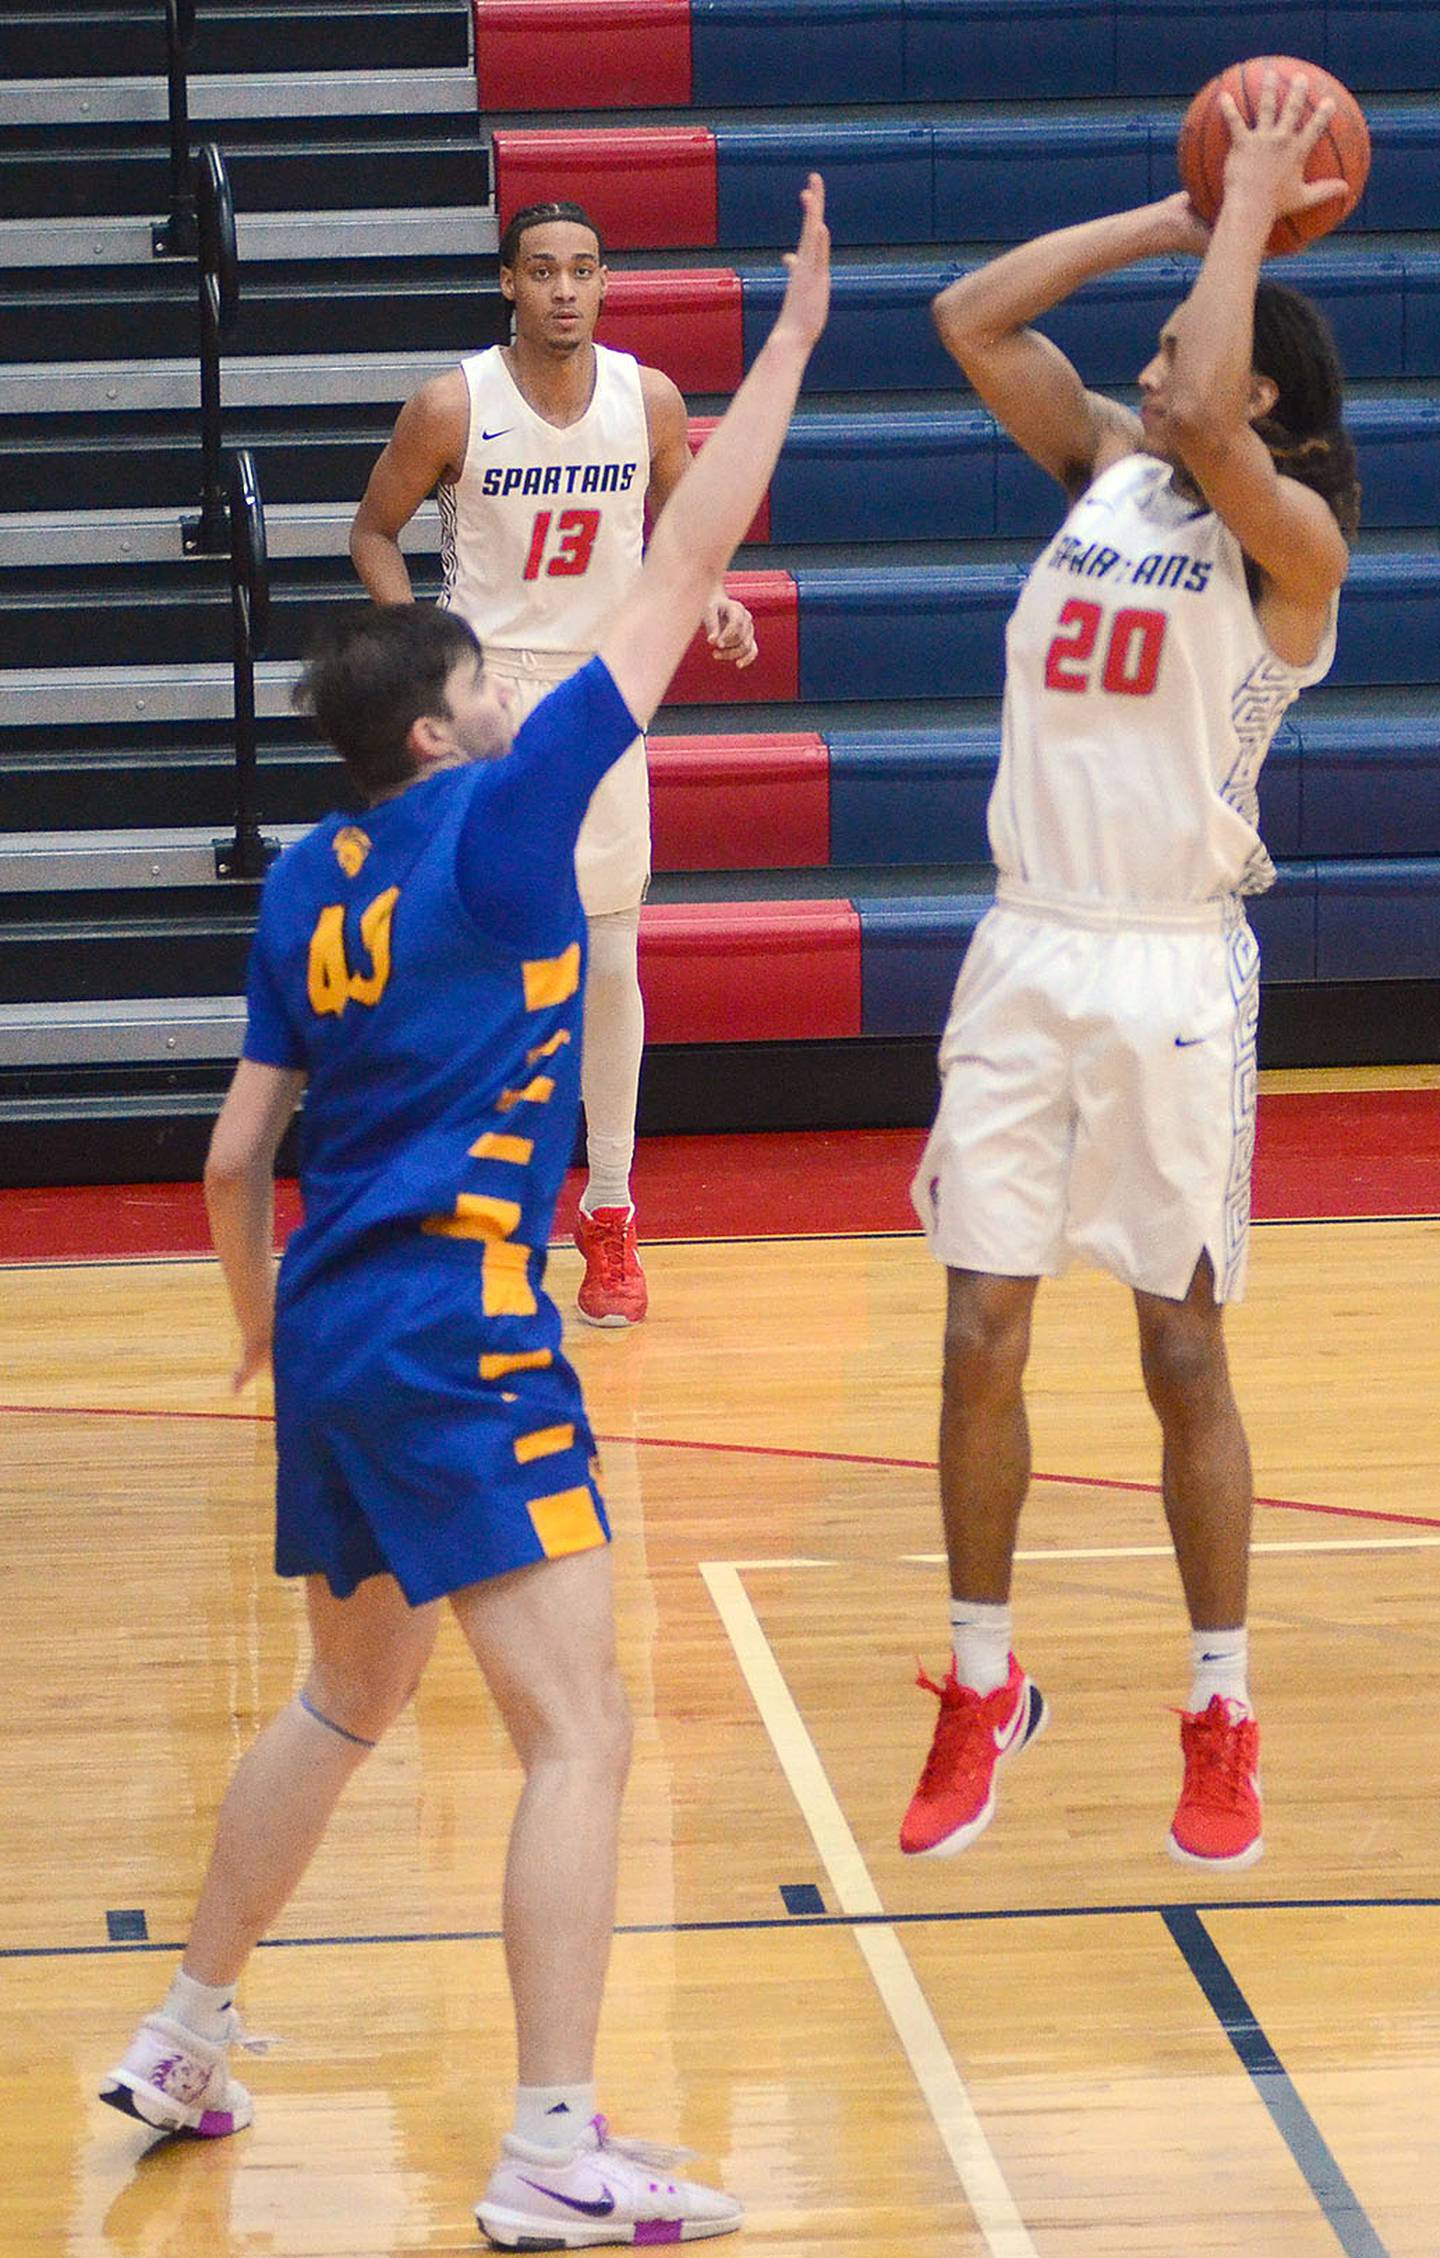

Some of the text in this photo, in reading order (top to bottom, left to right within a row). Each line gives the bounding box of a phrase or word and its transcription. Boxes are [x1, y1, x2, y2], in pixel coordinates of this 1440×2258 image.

[482, 463, 636, 496] SPARTANS
[523, 508, 601, 580] 13
[1049, 536, 1213, 592] PARANS
[1045, 598, 1168, 695] 20
